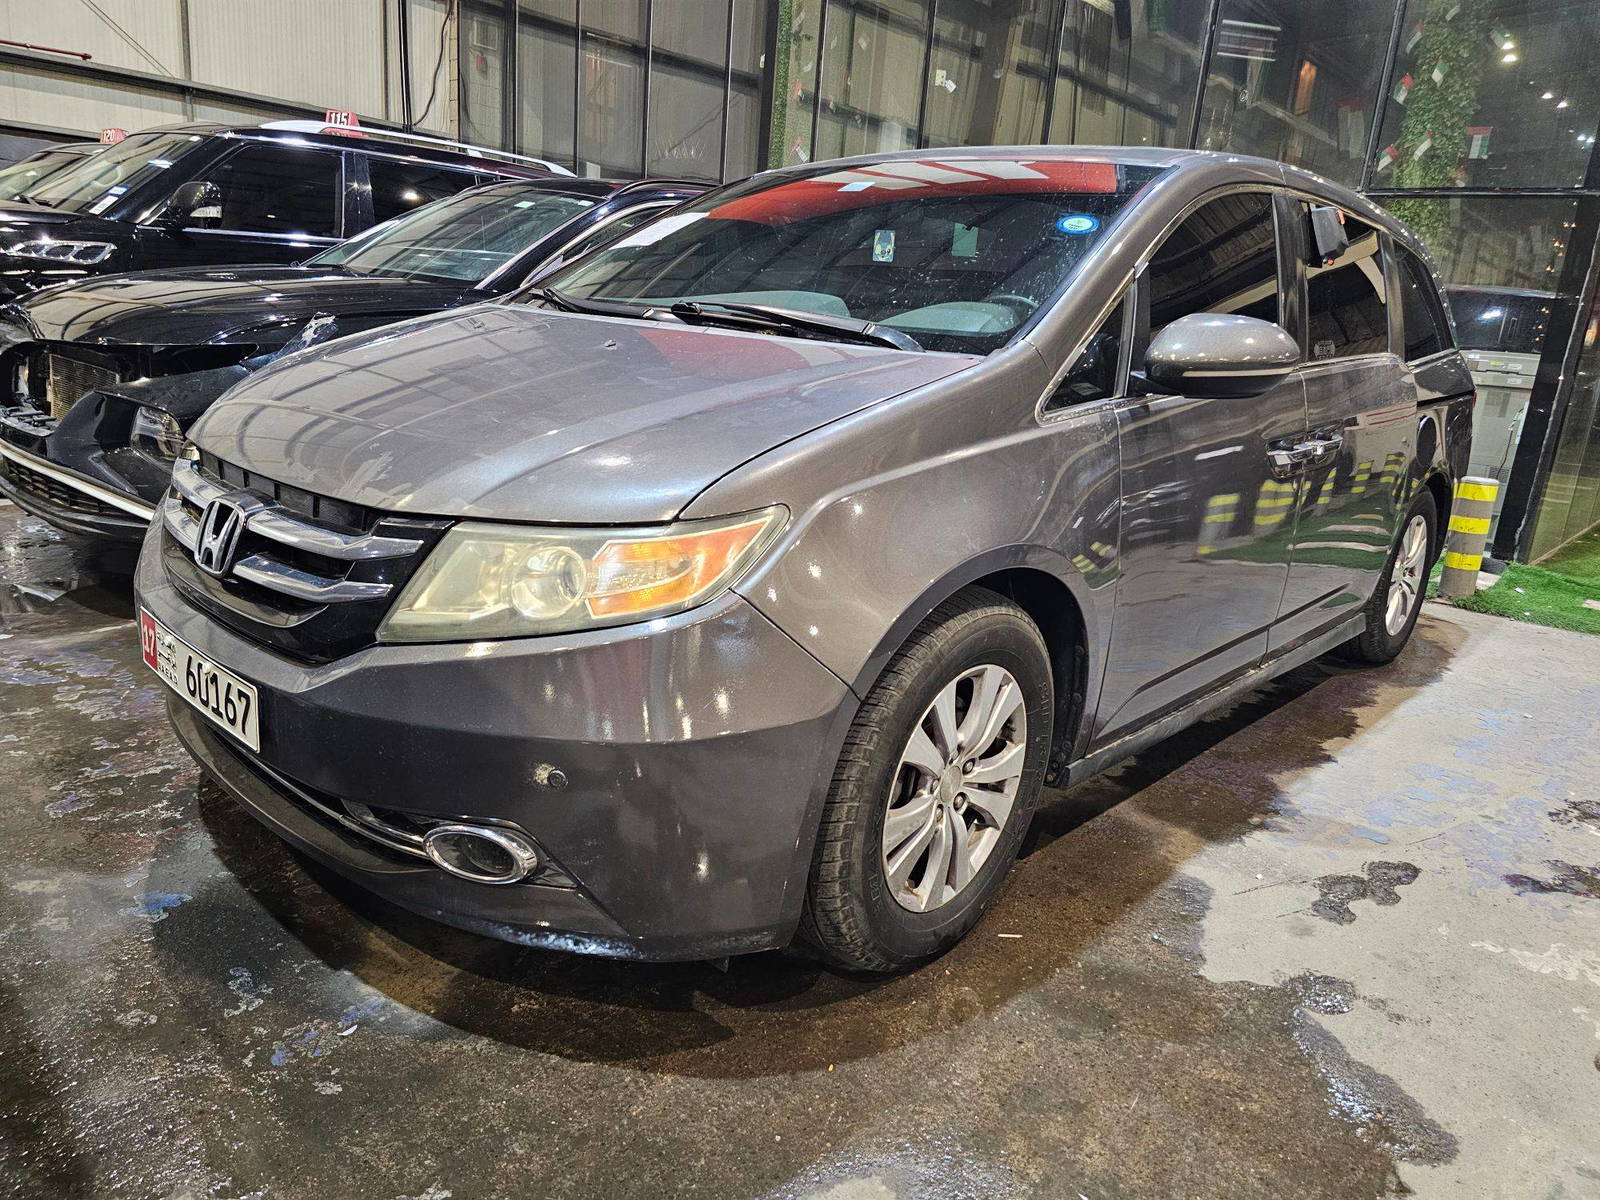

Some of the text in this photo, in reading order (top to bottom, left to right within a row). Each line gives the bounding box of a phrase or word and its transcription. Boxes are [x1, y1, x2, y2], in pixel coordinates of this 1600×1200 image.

[330, 111, 349, 126] 115
[143, 624, 155, 657] 17
[186, 655, 251, 735] 60167
